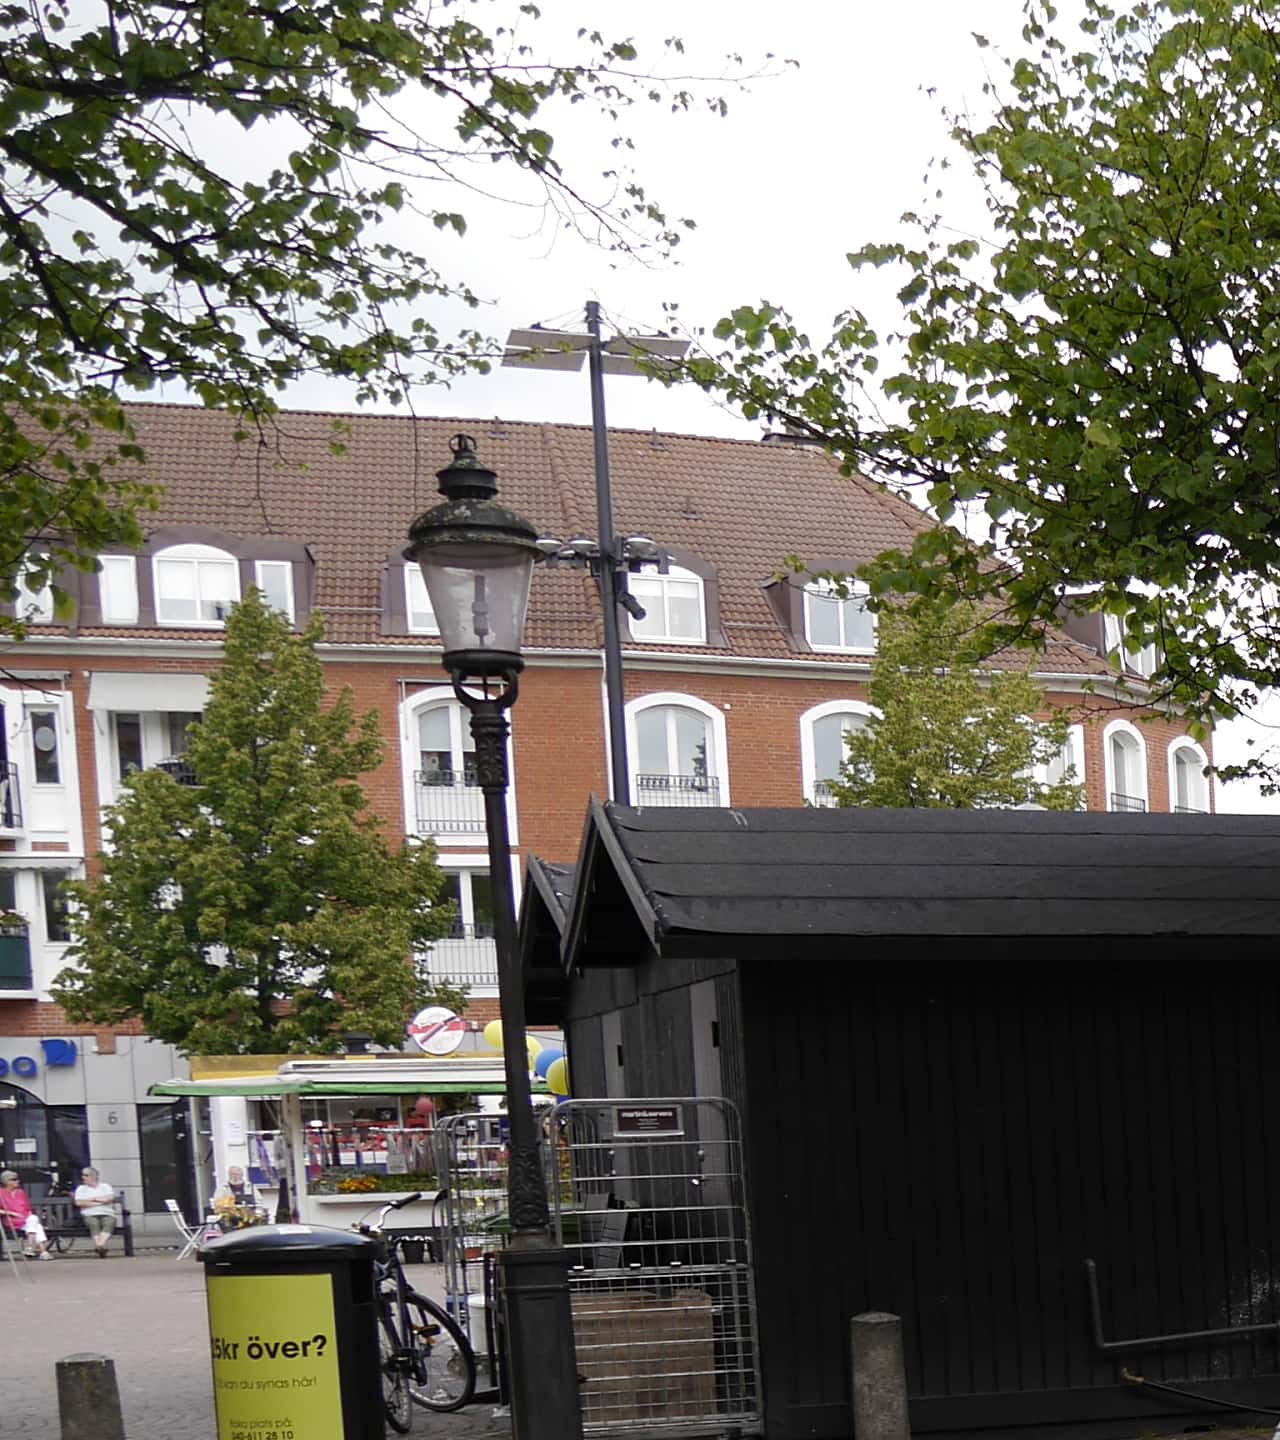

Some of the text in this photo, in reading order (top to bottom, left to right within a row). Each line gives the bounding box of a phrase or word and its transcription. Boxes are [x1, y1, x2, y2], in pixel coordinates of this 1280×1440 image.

[107, 1111, 118, 1125] 6
[247, 1334, 327, 1359] över?
[281, 1430, 294, 1440] 10
